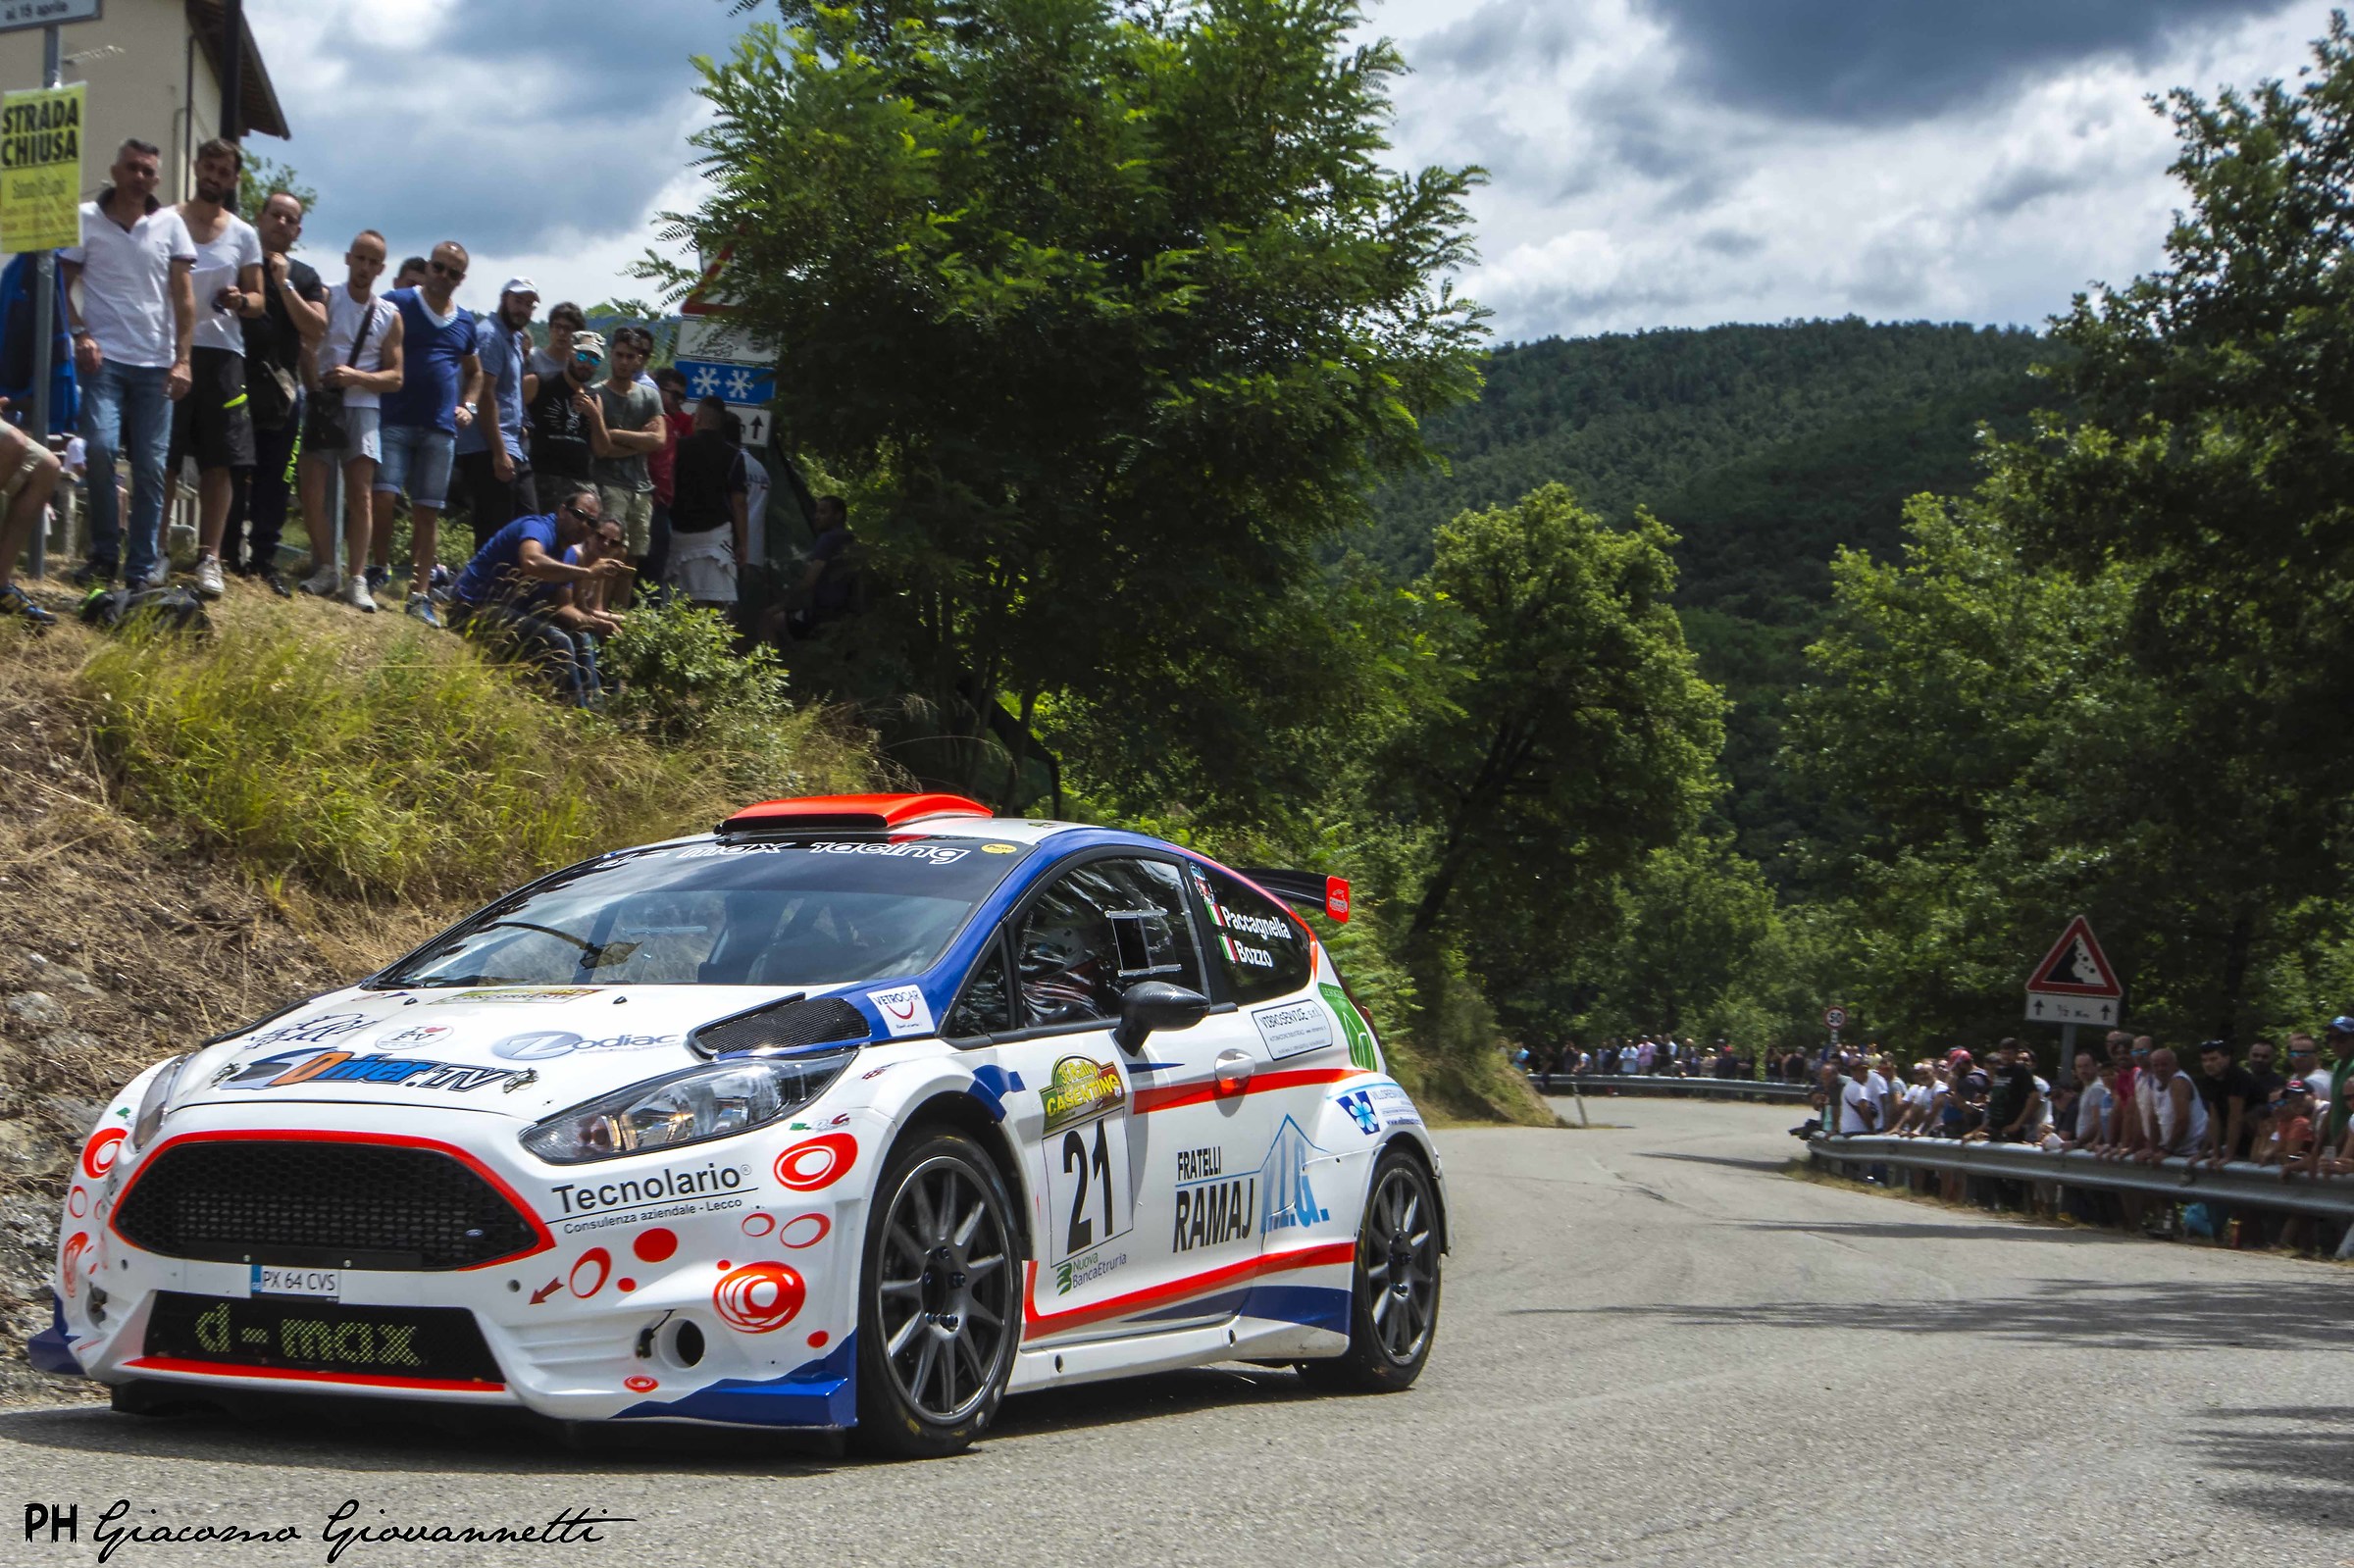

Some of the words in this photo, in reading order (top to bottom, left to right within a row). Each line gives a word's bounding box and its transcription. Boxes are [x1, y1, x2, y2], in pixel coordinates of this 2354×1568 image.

[3, 97, 78, 135] STRADA
[1, 128, 78, 167] CHIUSA
[809, 841, 971, 865] racing
[1220, 905, 1293, 940] Paccagnella
[1233, 939, 1274, 968] Bozzo
[873, 990, 921, 1006] VETROCAR
[1258, 1007, 1309, 1030] VIBROSERVICE
[1177, 1146, 1221, 1181] FRATELLI
[1062, 1118, 1113, 1255] 21
[563, 1214, 638, 1235] Consulenza
[640, 1203, 696, 1222] aziendale
[705, 1197, 742, 1212] Lecco
[1172, 1178, 1254, 1253] RAMAJ
[1072, 1252, 1099, 1273] Nuova
[1072, 1252, 1127, 1289] BancaEtruria
[262, 1270, 281, 1289] PX
[283, 1272, 303, 1290] 64
[307, 1273, 335, 1291] CVS
